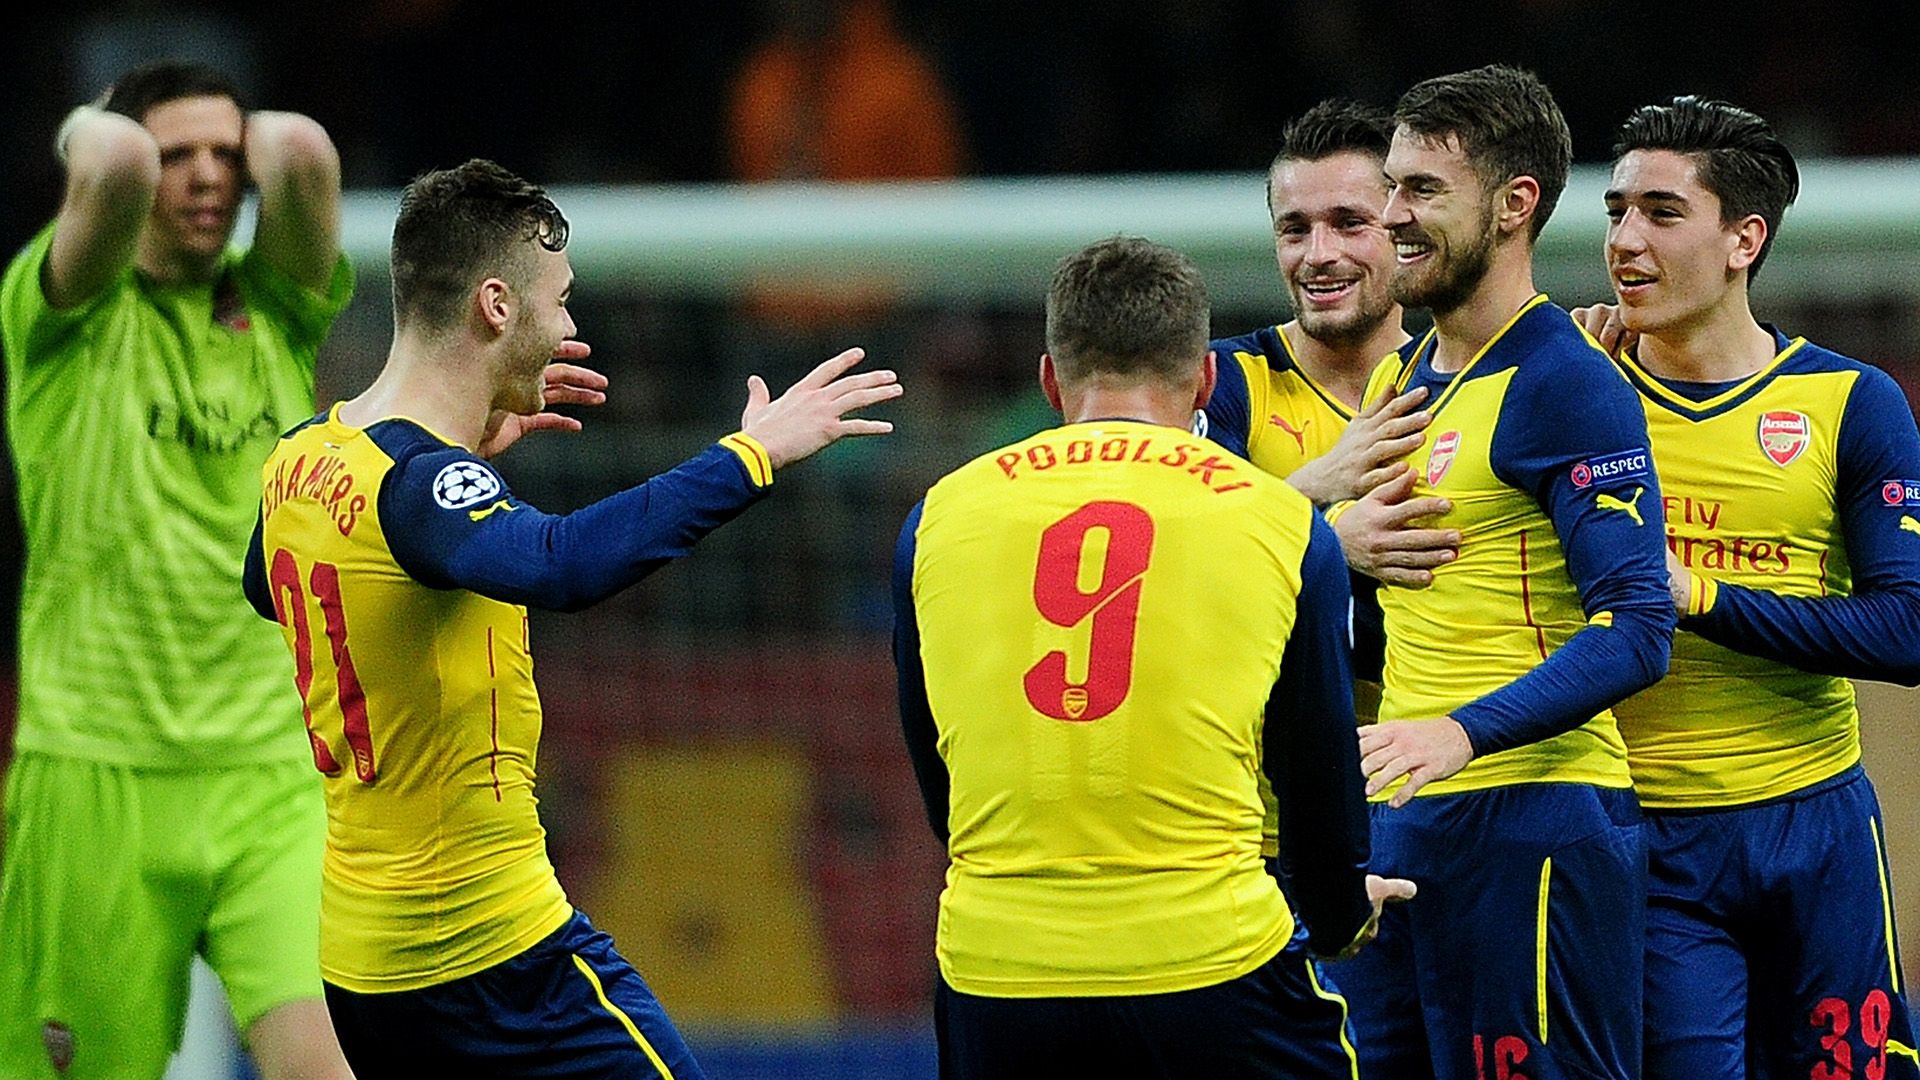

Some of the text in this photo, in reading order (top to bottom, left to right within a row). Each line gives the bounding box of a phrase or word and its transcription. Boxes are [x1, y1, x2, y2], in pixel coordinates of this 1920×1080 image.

[265, 454, 366, 536] CHAMBERS
[997, 439, 1252, 493] PODOLSKI
[1592, 455, 1646, 478] RESPECT
[1662, 496, 1720, 530] Fly
[1666, 527, 1791, 574] irates
[1024, 500, 1154, 721] 9
[270, 548, 376, 783] 21
[1810, 989, 1890, 1080] 39
